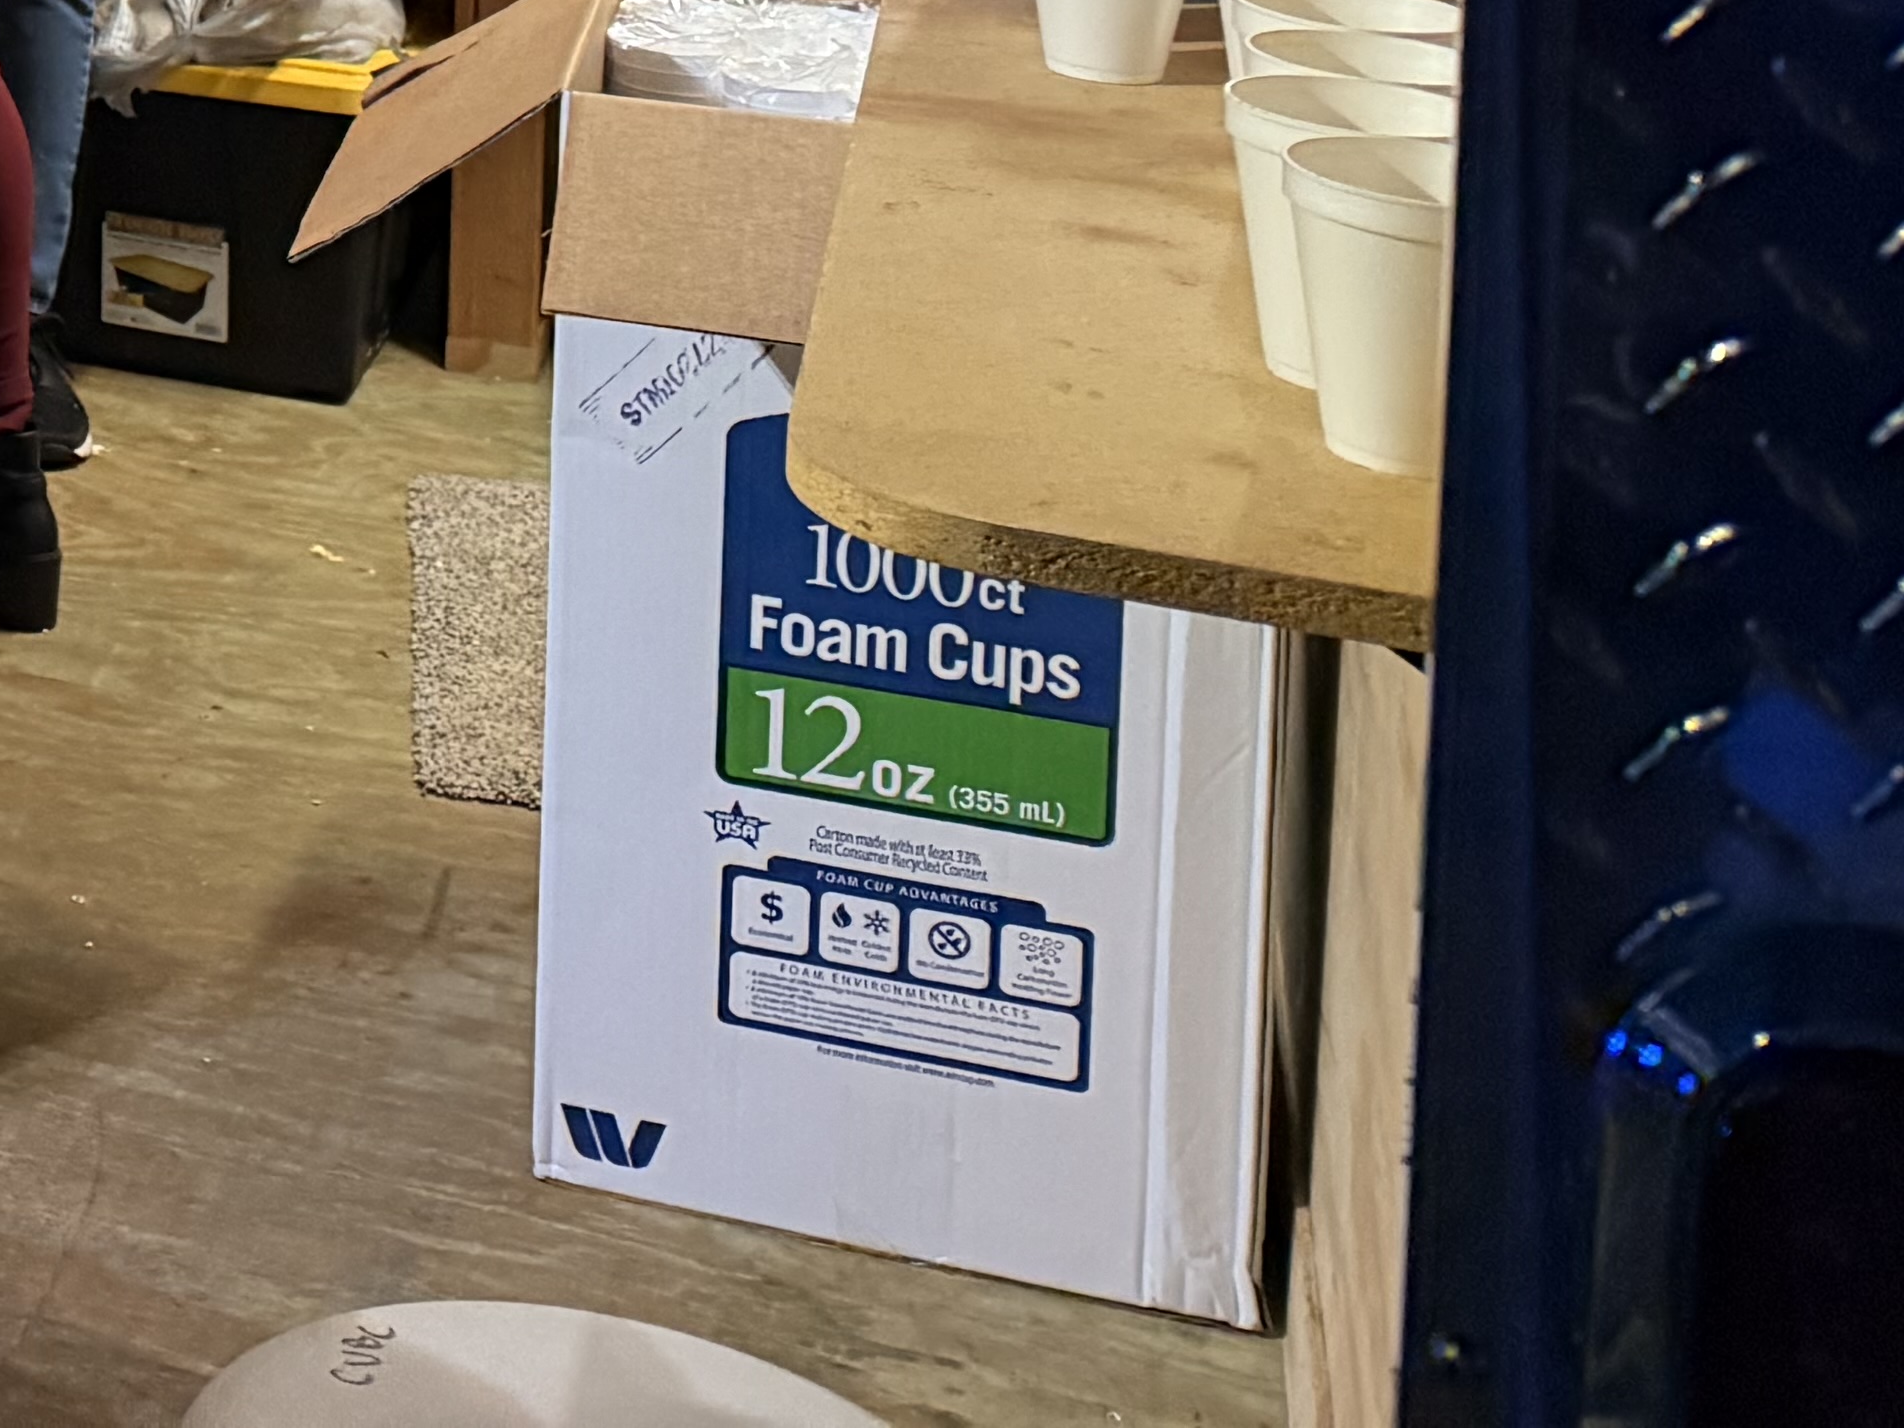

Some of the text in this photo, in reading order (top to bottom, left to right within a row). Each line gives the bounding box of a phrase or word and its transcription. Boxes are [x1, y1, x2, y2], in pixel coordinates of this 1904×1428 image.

[750, 594, 1082, 706] Foam Cups
[948, 784, 1011, 816] (355
[1018, 800, 1066, 828] mL)
[715, 819, 757, 840] USA
[809, 838, 833, 855] Post
[834, 843, 890, 865] Consumer
[855, 834, 888, 850] made
[816, 870, 999, 914] FOAM CUP ADVANTAGES
[779, 962, 825, 981] FOAM
[831, 972, 971, 1010] ENVIRONMENTAL
[977, 998, 1031, 1021] FACTS
